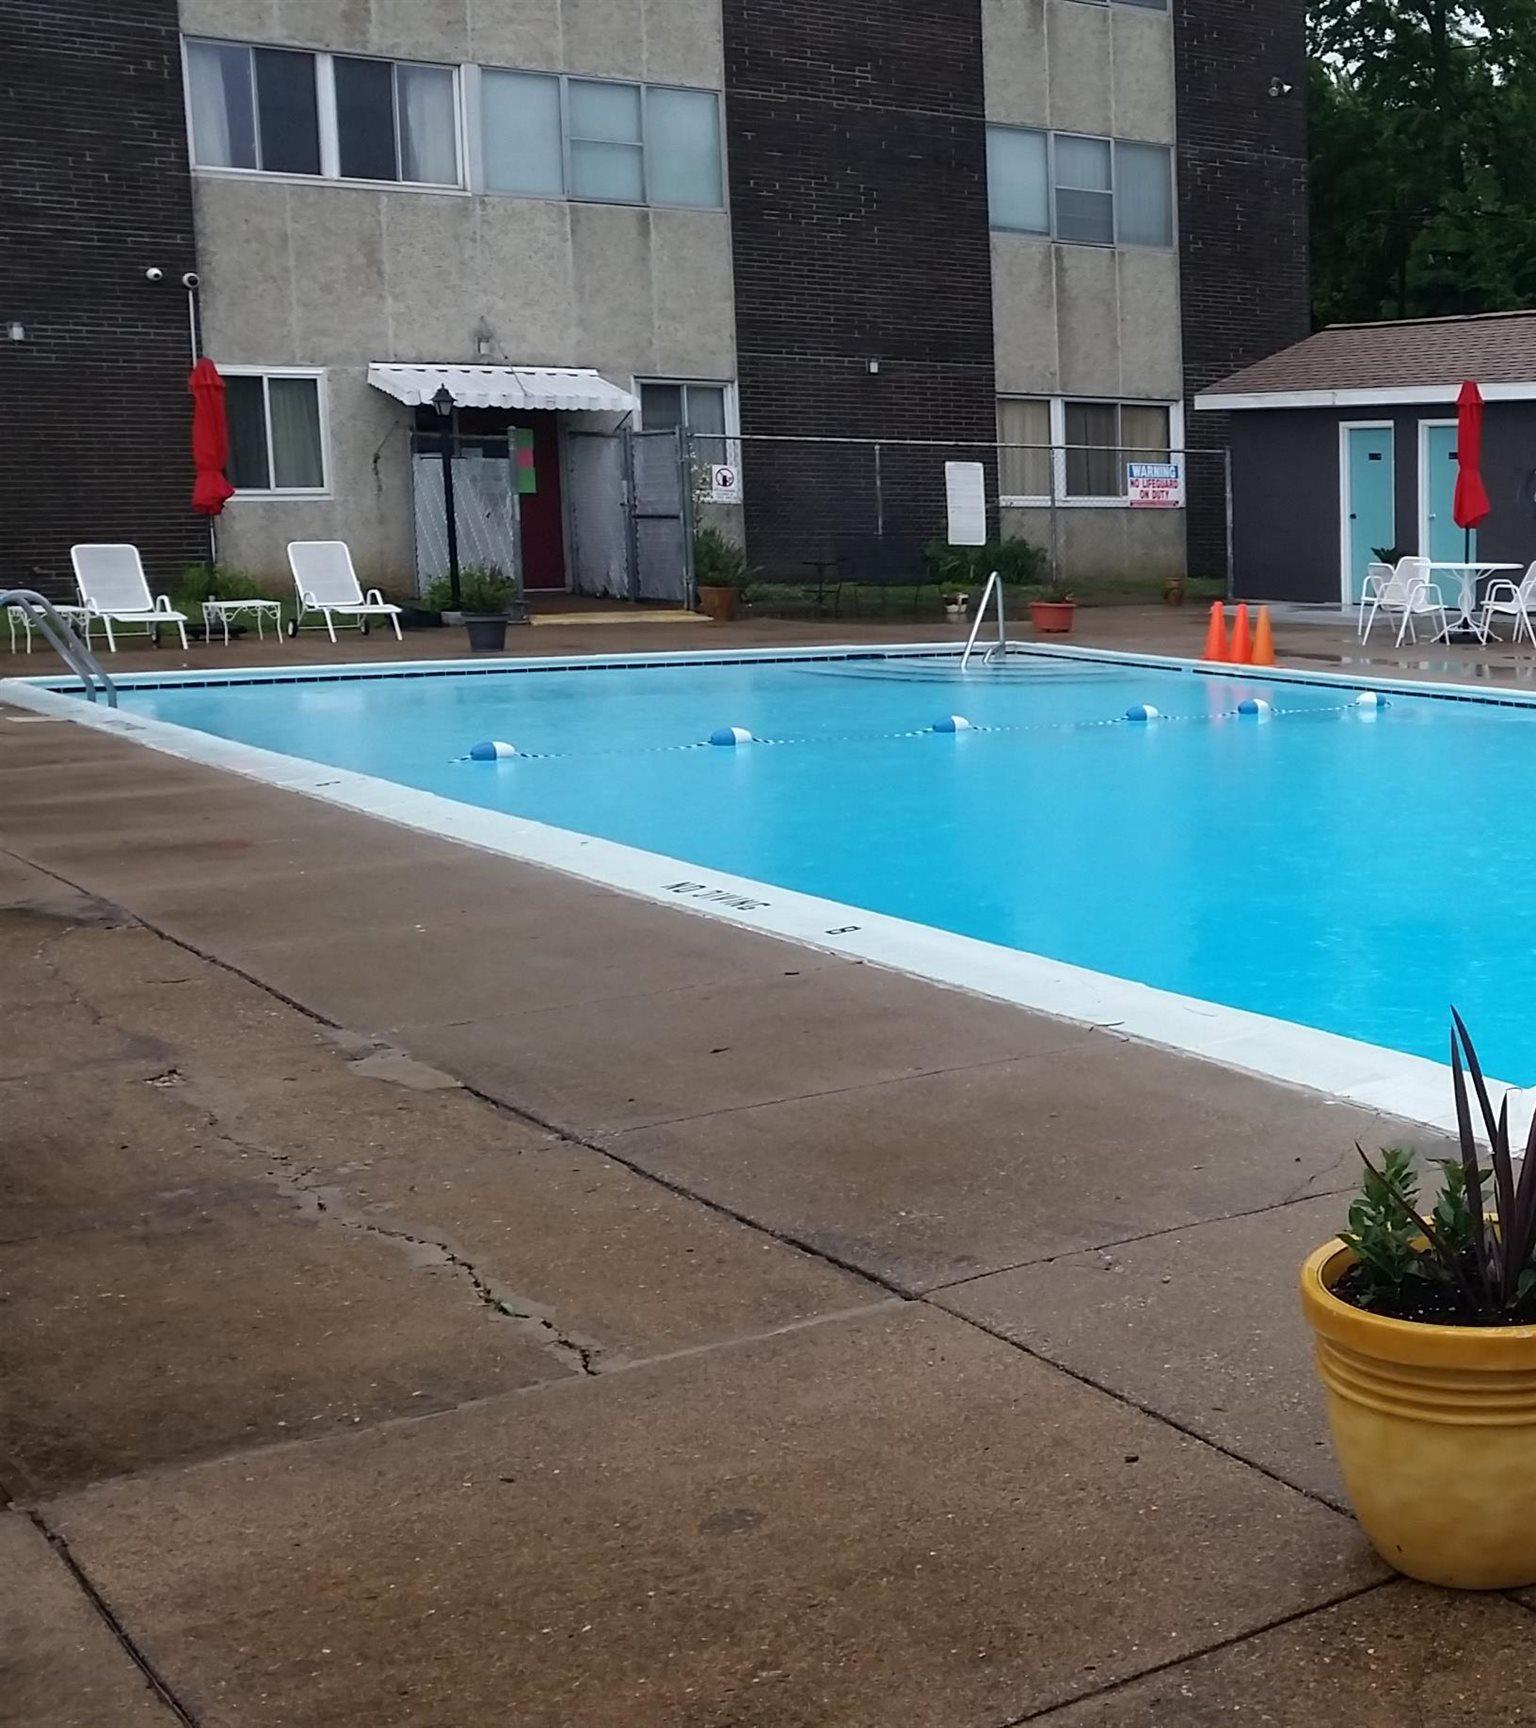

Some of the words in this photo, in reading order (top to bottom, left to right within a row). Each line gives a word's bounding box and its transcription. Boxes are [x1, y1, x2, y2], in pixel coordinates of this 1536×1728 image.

[1132, 465, 1176, 478] WARNING
[1130, 479, 1139, 488] NO
[1142, 479, 1178, 489] LIFEGUARD
[1140, 490, 1149, 499] ON
[1152, 490, 1169, 499] DUTY
